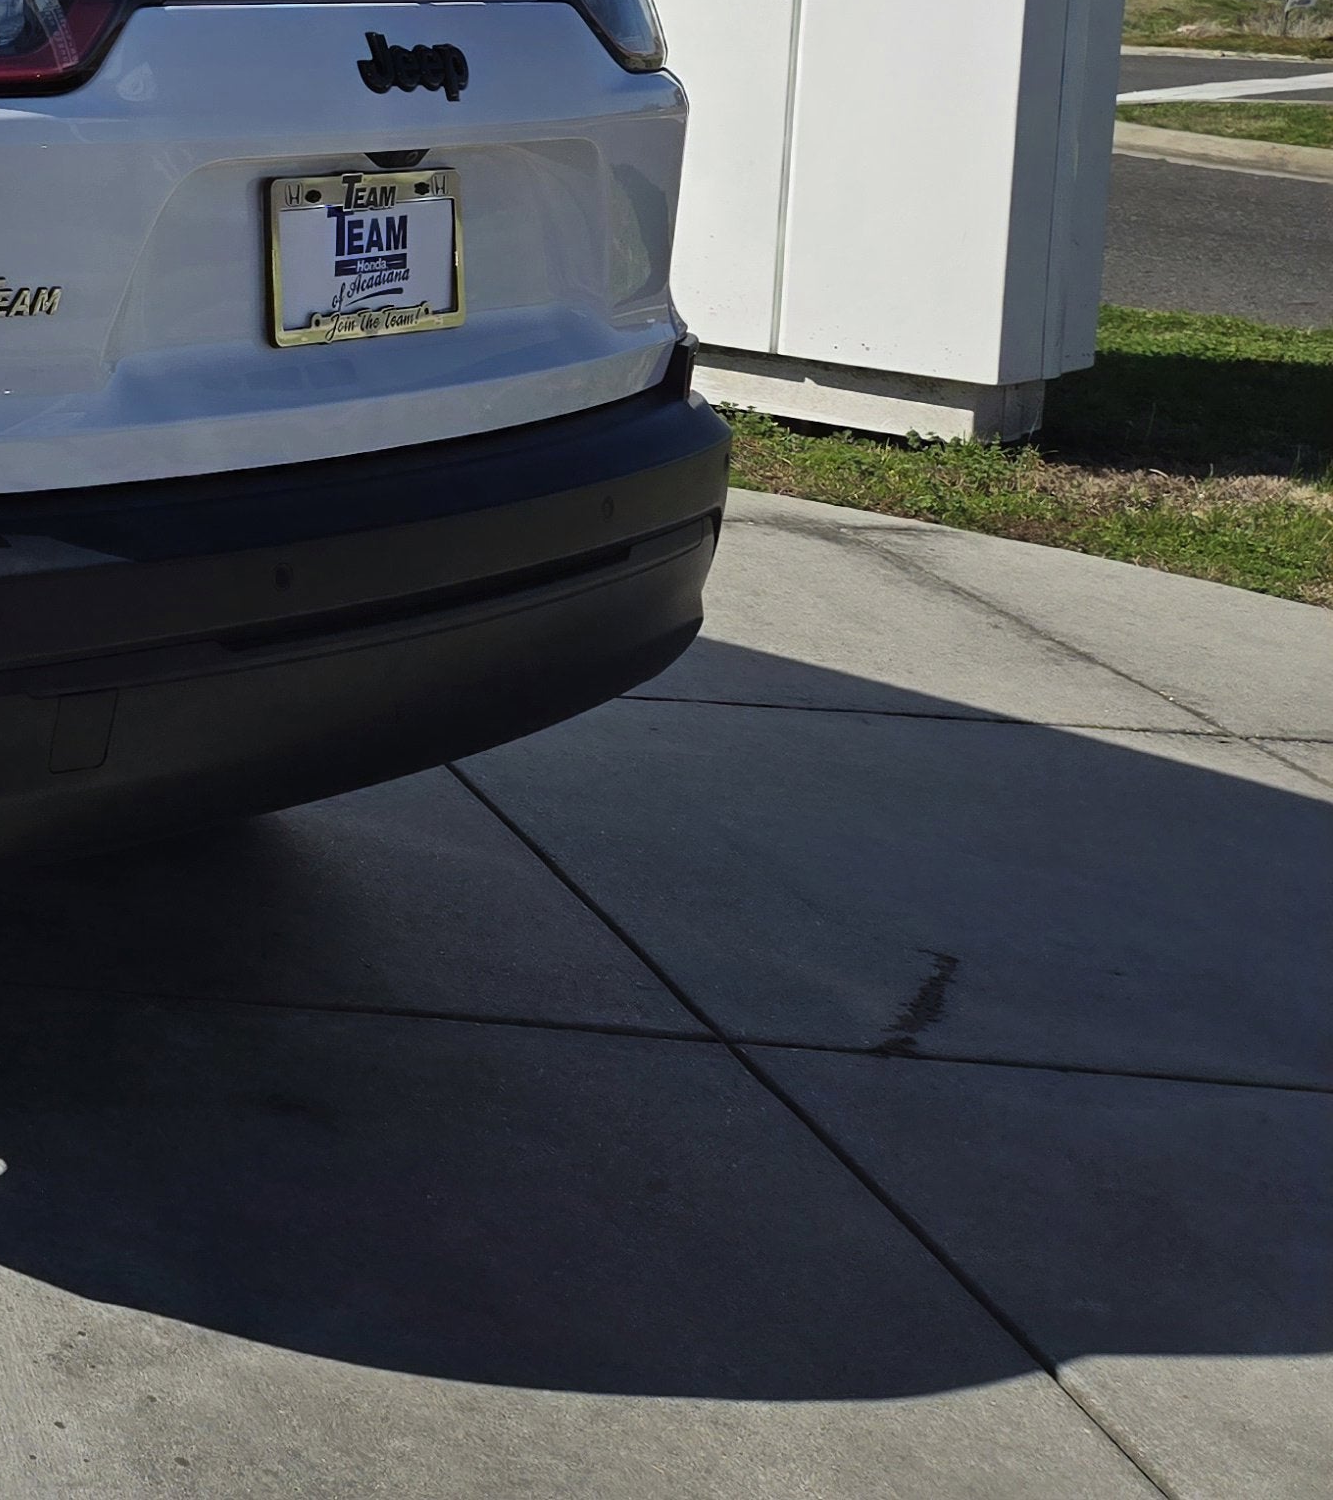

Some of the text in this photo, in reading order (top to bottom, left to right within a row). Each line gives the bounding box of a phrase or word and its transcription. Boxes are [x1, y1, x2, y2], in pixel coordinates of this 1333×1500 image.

[357, 31, 469, 102] Jeep
[341, 173, 397, 210] TEAM
[327, 206, 408, 257] TEAM
[356, 257, 388, 272] Honda
[346, 268, 410, 298] Acadiana
[325, 313, 355, 340] Join
[357, 310, 381, 331] The
